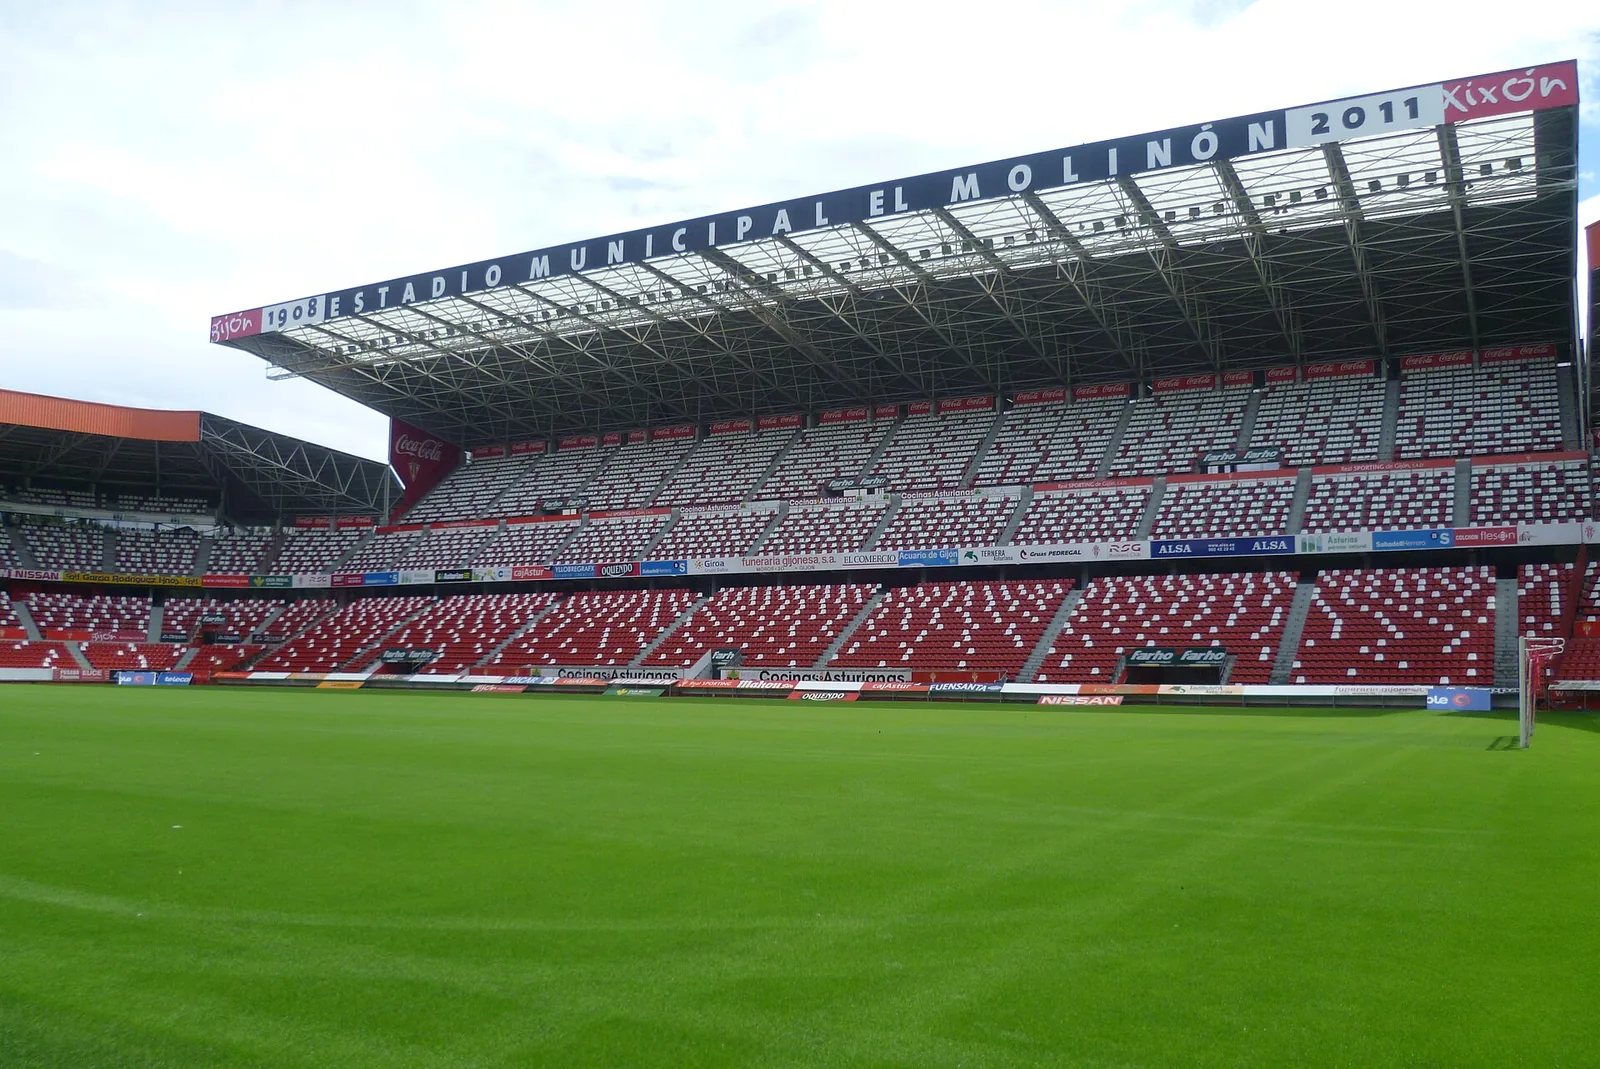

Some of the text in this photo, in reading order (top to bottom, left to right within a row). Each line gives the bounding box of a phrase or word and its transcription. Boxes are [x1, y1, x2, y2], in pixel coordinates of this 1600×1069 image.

[1311, 96, 1419, 135] 2011
[330, 120, 1275, 317] ESTADIO MUNICIPAL EL MOLINÓN
[268, 298, 317, 328] 1908
[395, 434, 441, 462] Coca-Cola
[1203, 451, 1278, 462] farho farho
[934, 489, 974, 497] Asturianas
[1158, 544, 1192, 554] ALSA
[1252, 541, 1288, 550] ALSA
[854, 554, 896, 563] COMERCIO
[900, 551, 927, 560] Acuario
[742, 558, 780, 566] funeraria
[602, 564, 632, 575] OQUENDO
[15, 570, 59, 580] NISSAN
[712, 651, 735, 659] farh
[1130, 650, 1225, 660] farho farho
[558, 668, 678, 679] Cocinas Asturianas
[760, 670, 904, 682] Cocinas Asturianas
[737, 680, 781, 688] Mahou
[930, 683, 987, 692] FUENSANTA
[1042, 696, 1121, 704] NISSAN
